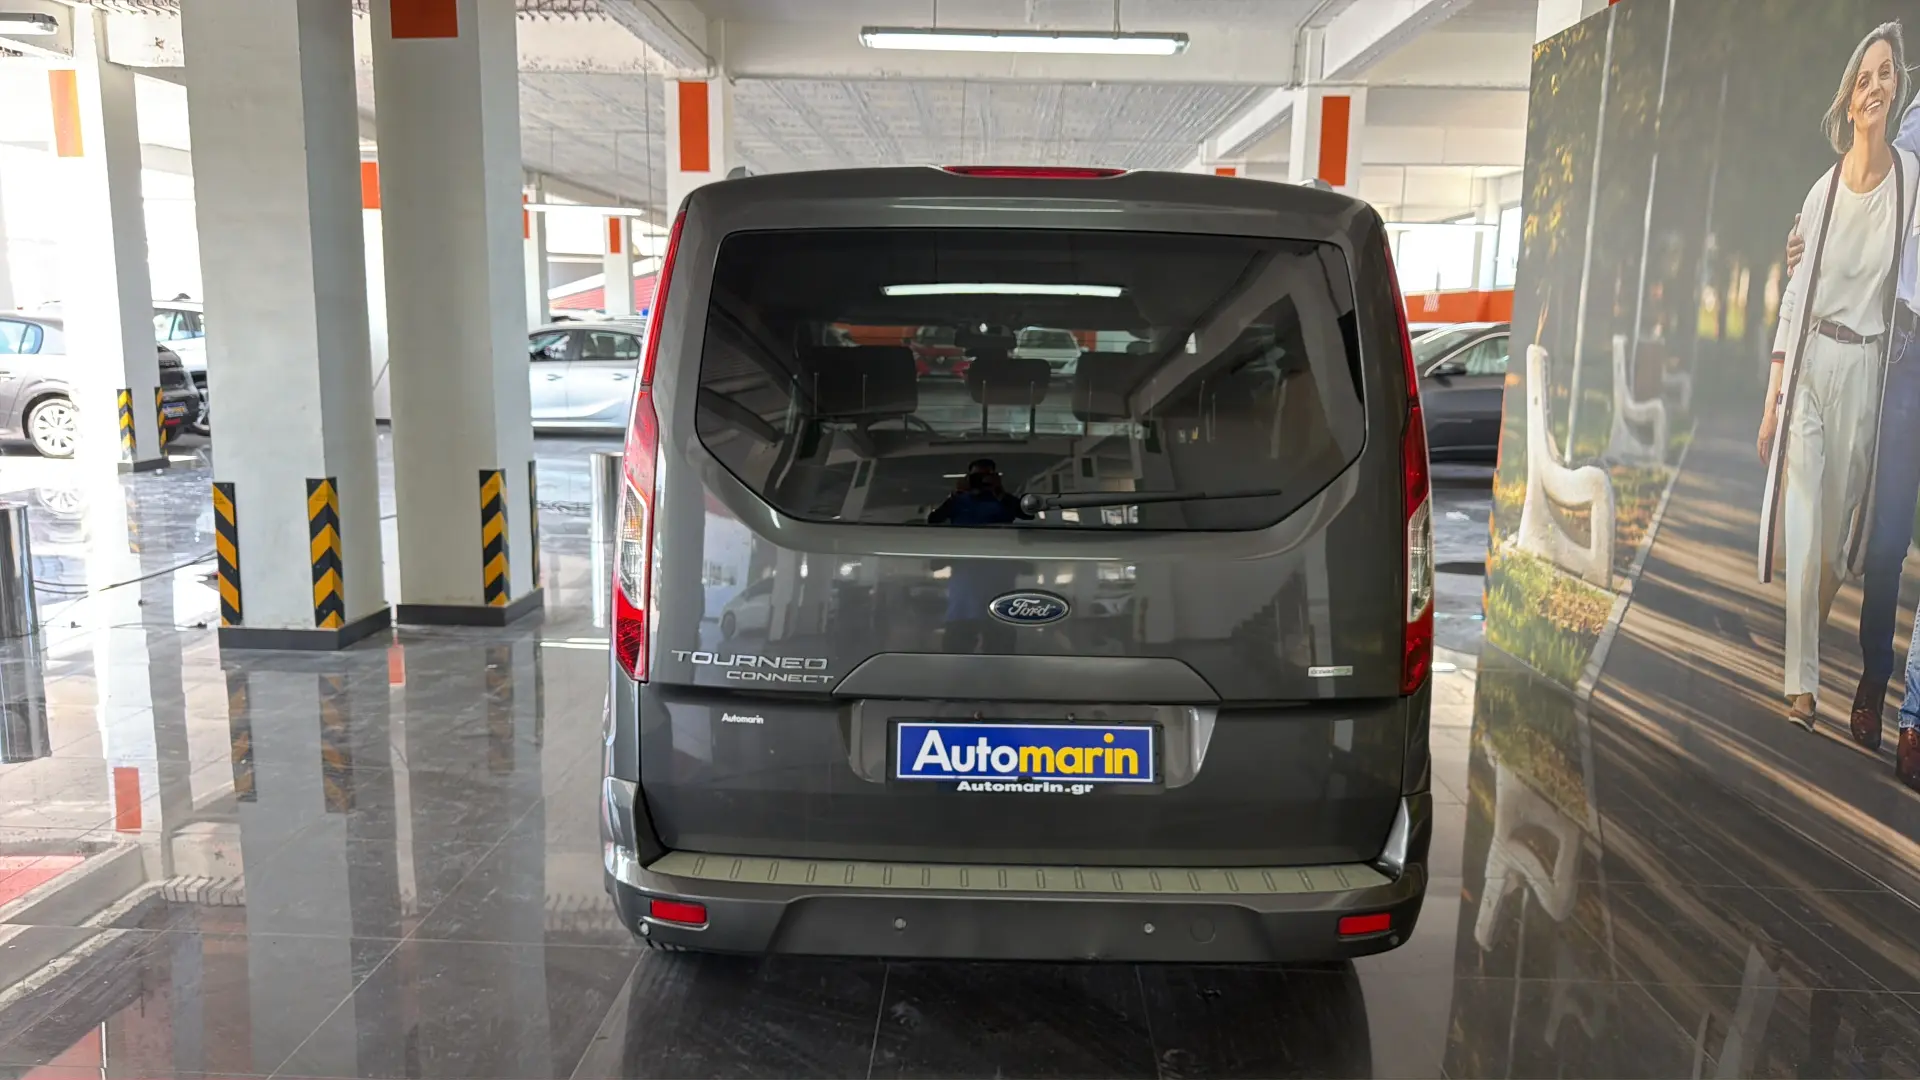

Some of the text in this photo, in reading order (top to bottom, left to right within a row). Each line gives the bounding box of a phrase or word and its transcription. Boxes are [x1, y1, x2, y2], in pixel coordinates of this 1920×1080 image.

[1007, 598, 1050, 616] Ford
[671, 650, 828, 670] TOURNEO
[726, 670, 834, 684] CONNECT
[721, 712, 764, 725] Automarin
[911, 729, 1139, 775] Automarin
[956, 780, 1094, 796] Automarin.gr
